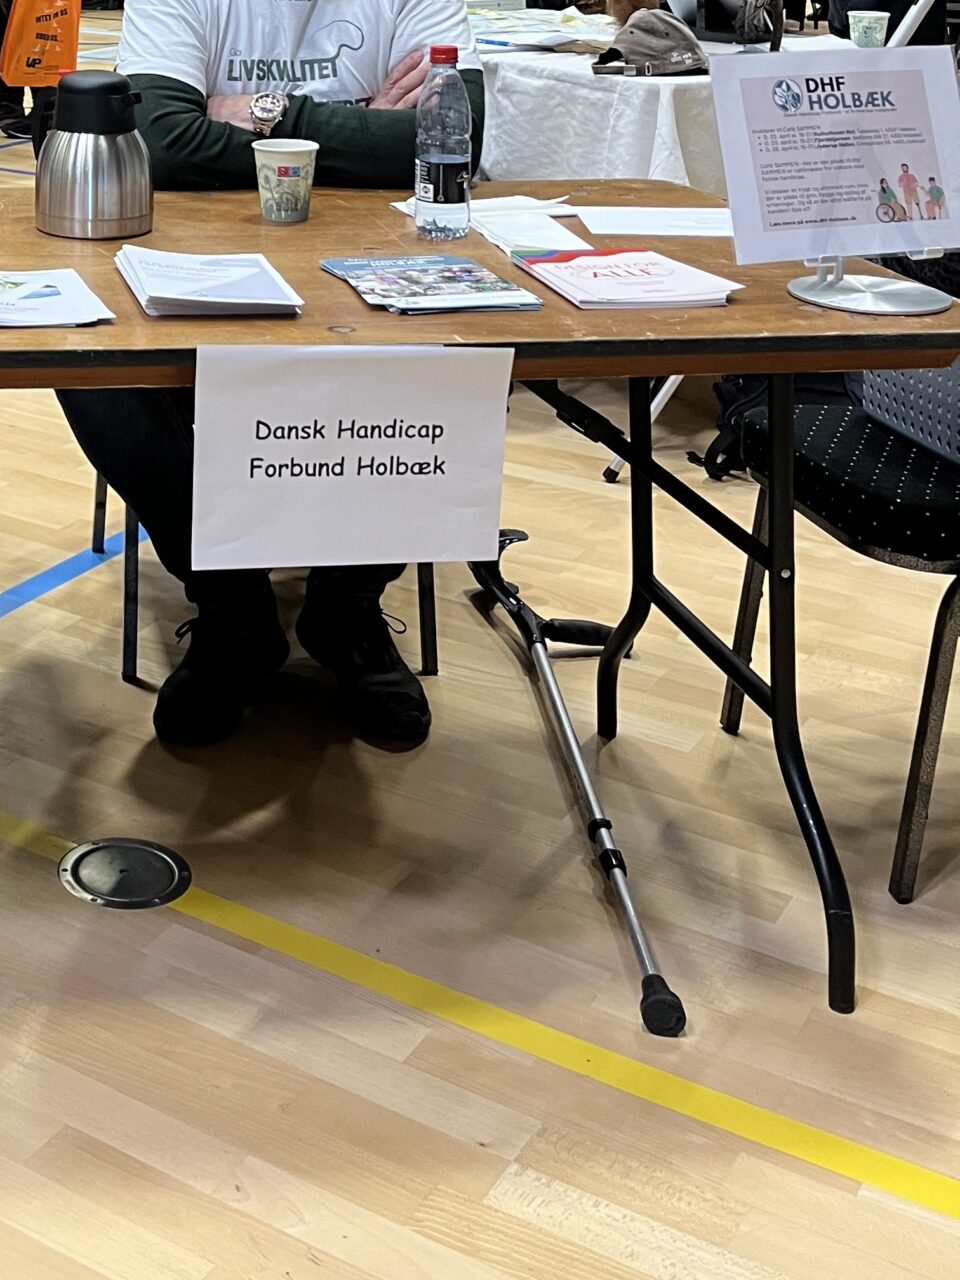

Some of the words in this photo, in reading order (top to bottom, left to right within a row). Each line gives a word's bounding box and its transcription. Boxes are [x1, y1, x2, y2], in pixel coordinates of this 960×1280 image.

[805, 76, 845, 93] DHF
[808, 91, 896, 111] HOLBÆK
[255, 419, 326, 440] Dansk
[337, 418, 444, 444] Handicap
[249, 456, 345, 479] Forbund
[356, 455, 446, 476] Holbæk
